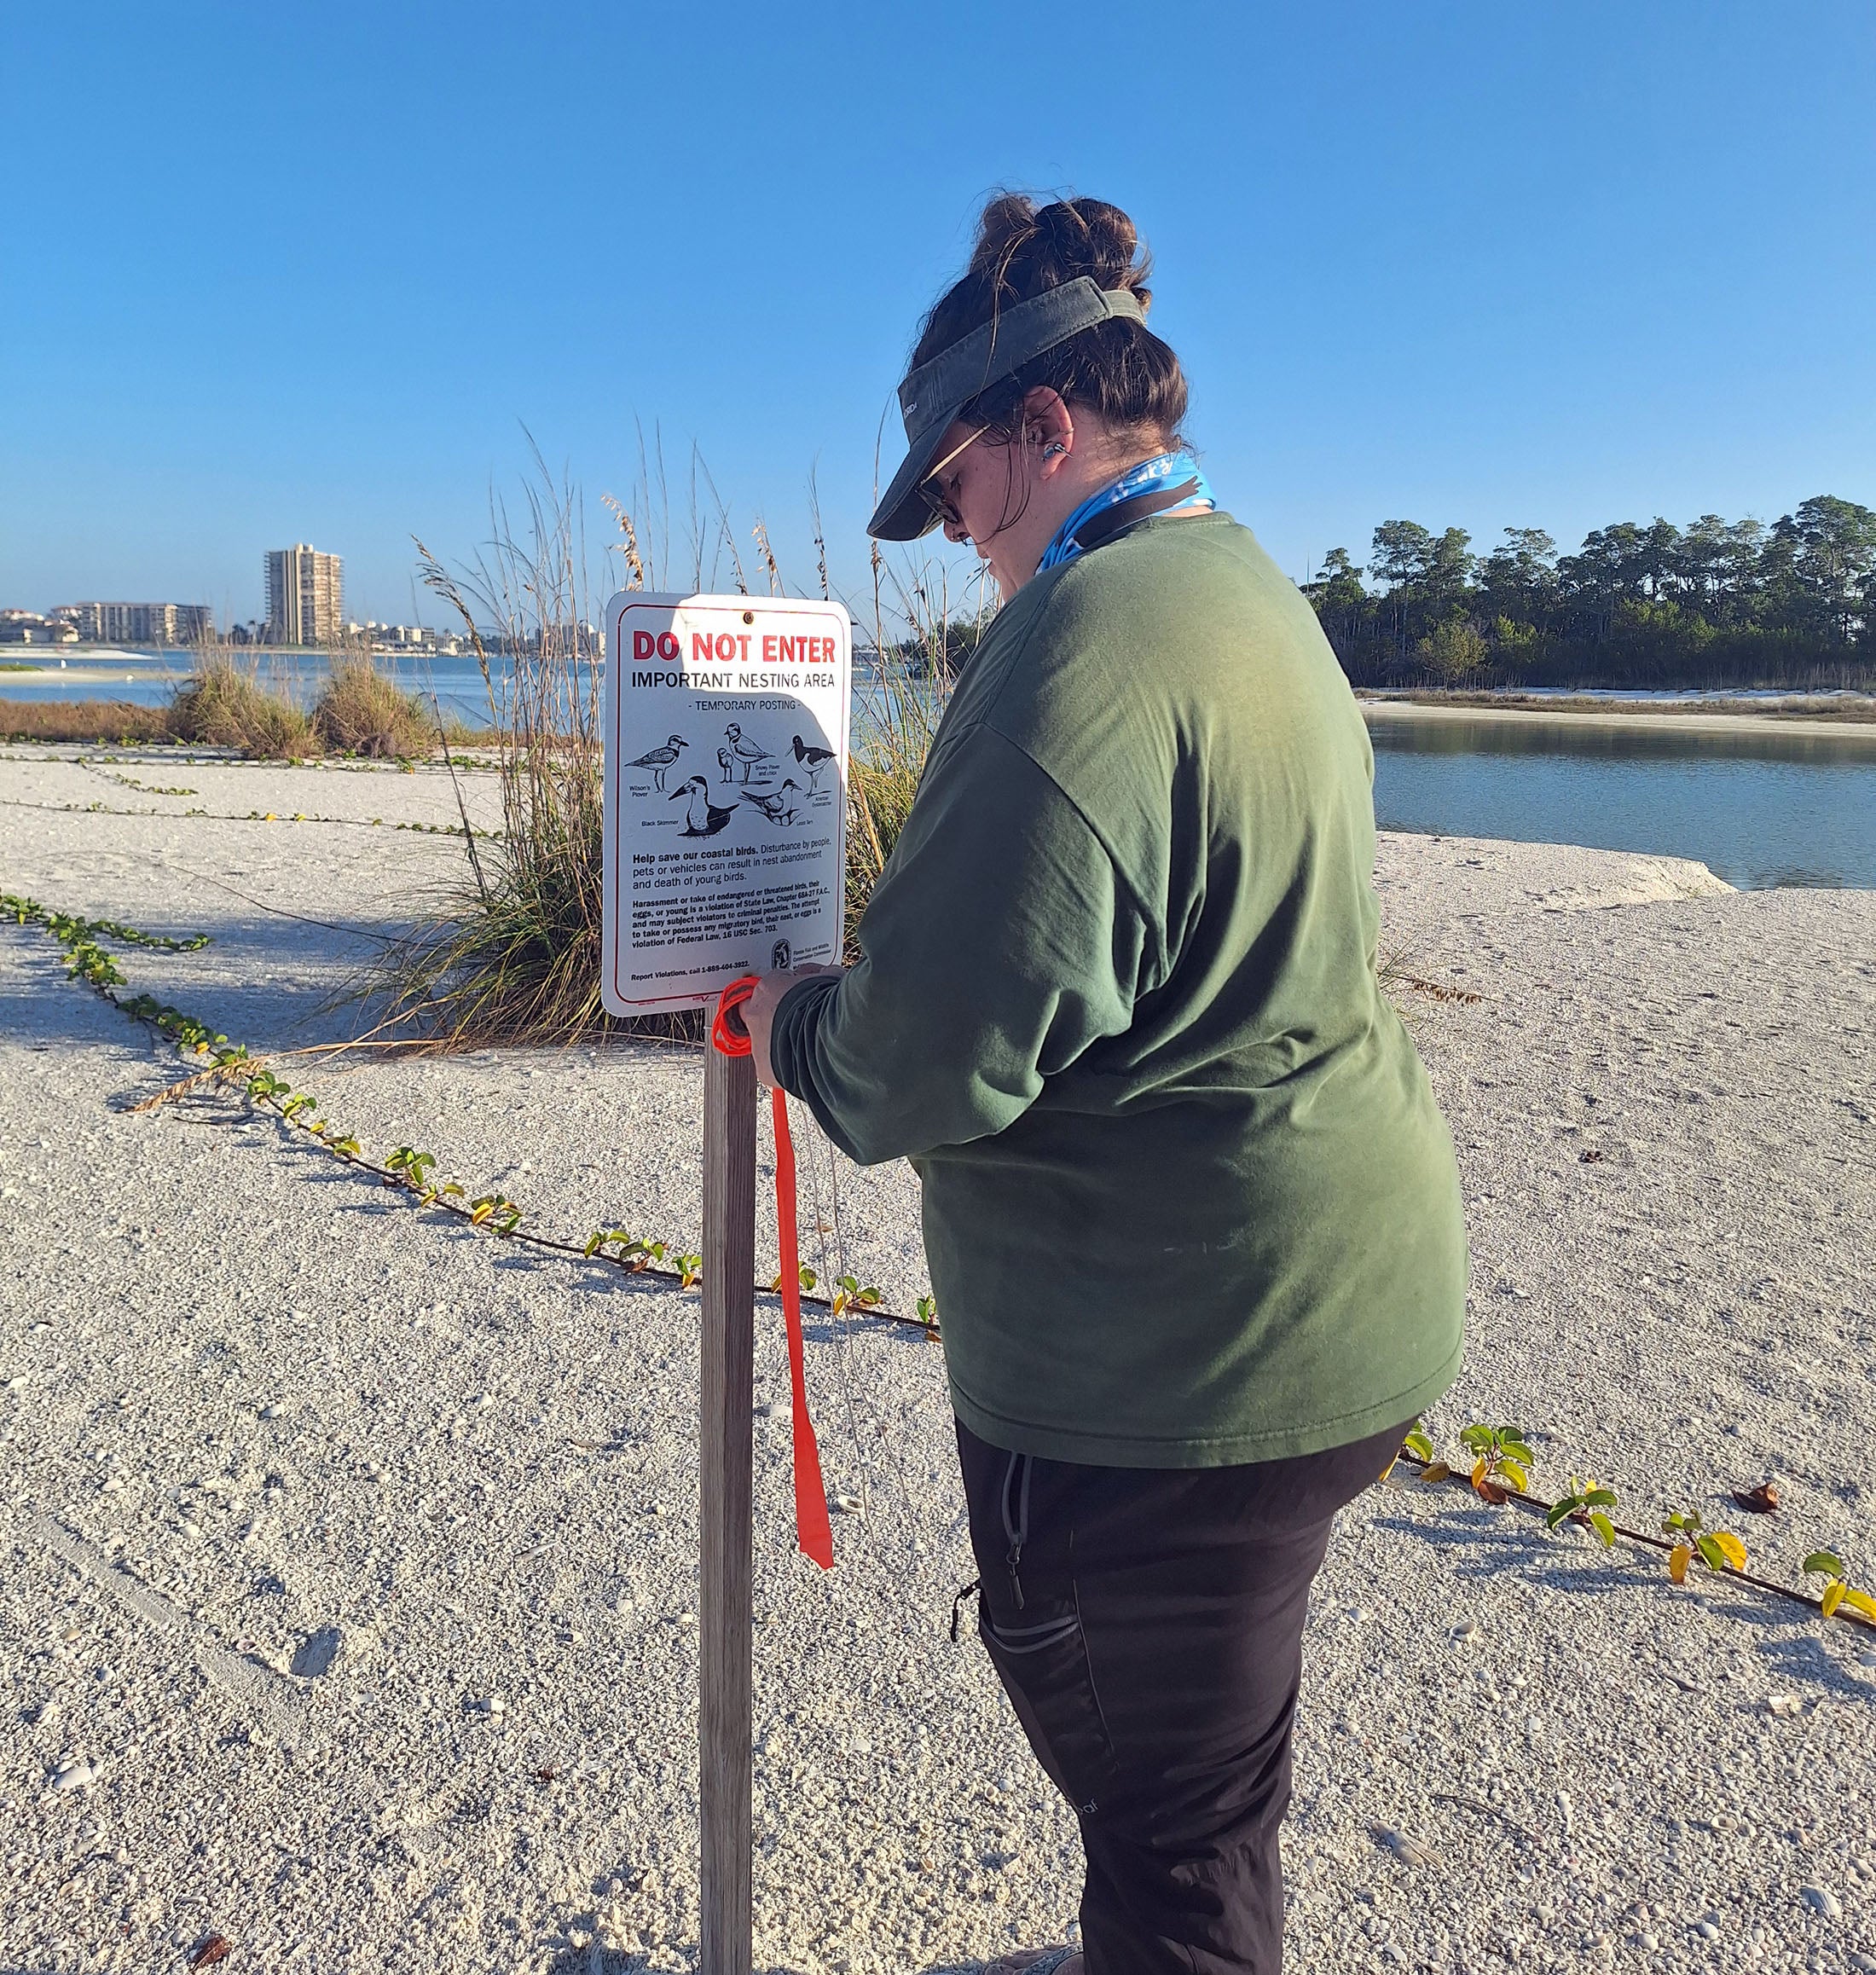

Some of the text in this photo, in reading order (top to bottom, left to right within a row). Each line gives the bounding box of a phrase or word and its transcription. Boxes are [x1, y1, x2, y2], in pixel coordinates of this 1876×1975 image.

[634, 630, 836, 663] DO NOT ENTER
[632, 672, 835, 687] IMPORTANT NESTING AREA
[695, 700, 756, 710] TEMPORARY
[760, 700, 796, 710] POSTING
[633, 854, 655, 865] Help
[658, 854, 680, 862] save
[701, 848, 733, 859] coastal
[736, 847, 758, 856] birds.
[761, 842, 801, 854] Disturbance
[802, 839, 809, 849] by
[811, 837, 831, 848] people,
[633, 866, 654, 878] pets
[669, 863, 707, 874] vehicles
[709, 862, 725, 871] can
[727, 859, 751, 869] result
[753, 858, 760, 866] in
[762, 856, 779, 866] nest
[780, 850, 822, 863] abandonment
[633, 872, 747, 889] and death of young birds.
[632, 911, 654, 919] eggs,
[665, 906, 688, 917] young
[704, 901, 734, 912] violation
[736, 900, 743, 908] of
[744, 898, 761, 907] State
[776, 893, 796, 903] Chapter
[633, 897, 678, 908] Harassment
[716, 889, 755, 901] endangered
[764, 884, 794, 895] threatened
[632, 920, 646, 929] and
[649, 919, 664, 928] may
[667, 916, 694, 926] subject
[697, 912, 727, 923] violators
[737, 908, 761, 918] criminal
[763, 904, 790, 916] penalties.
[802, 898, 819, 908] attempt
[673, 925, 702, 935] possess
[718, 918, 750, 930] migratory
[751, 917, 765, 925] bird,
[766, 914, 779, 924] their
[632, 939, 665, 948] violation
[676, 934, 704, 944] Federal
[722, 930, 732, 939] 16
[733, 929, 748, 937] USC
[749, 927, 763, 935] Sec.
[765, 924, 778, 934] 703.
[631, 973, 653, 982] Report
[655, 969, 687, 978] Violations,
